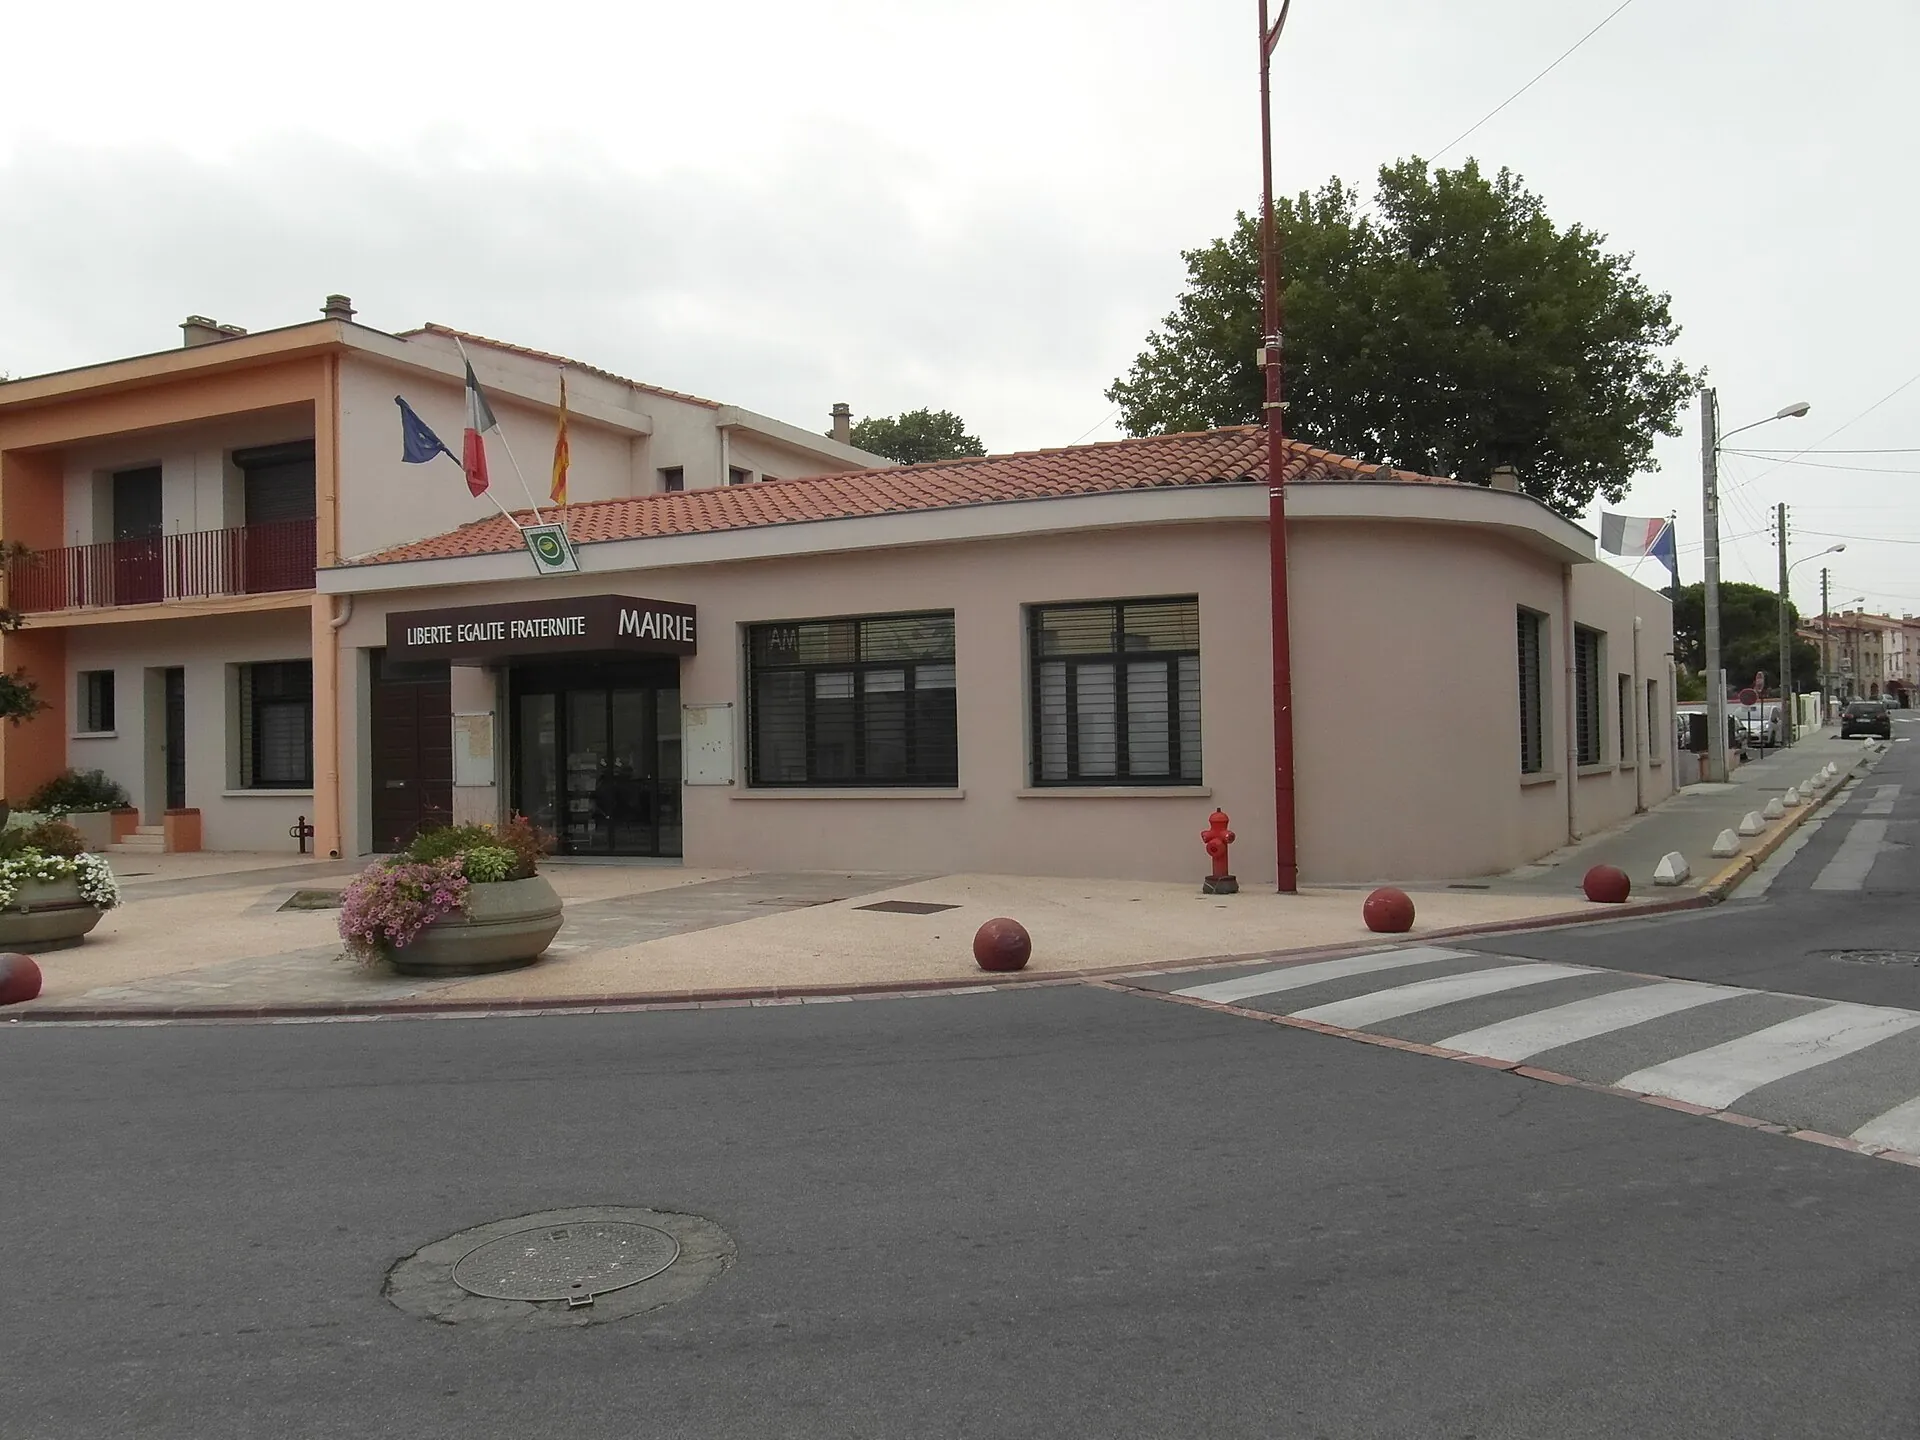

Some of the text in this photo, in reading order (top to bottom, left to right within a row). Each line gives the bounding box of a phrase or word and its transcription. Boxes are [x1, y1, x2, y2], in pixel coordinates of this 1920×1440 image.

[407, 616, 586, 645] LIBERTE EGALITE FRATERNITE
[618, 608, 694, 642] MAIRIE
